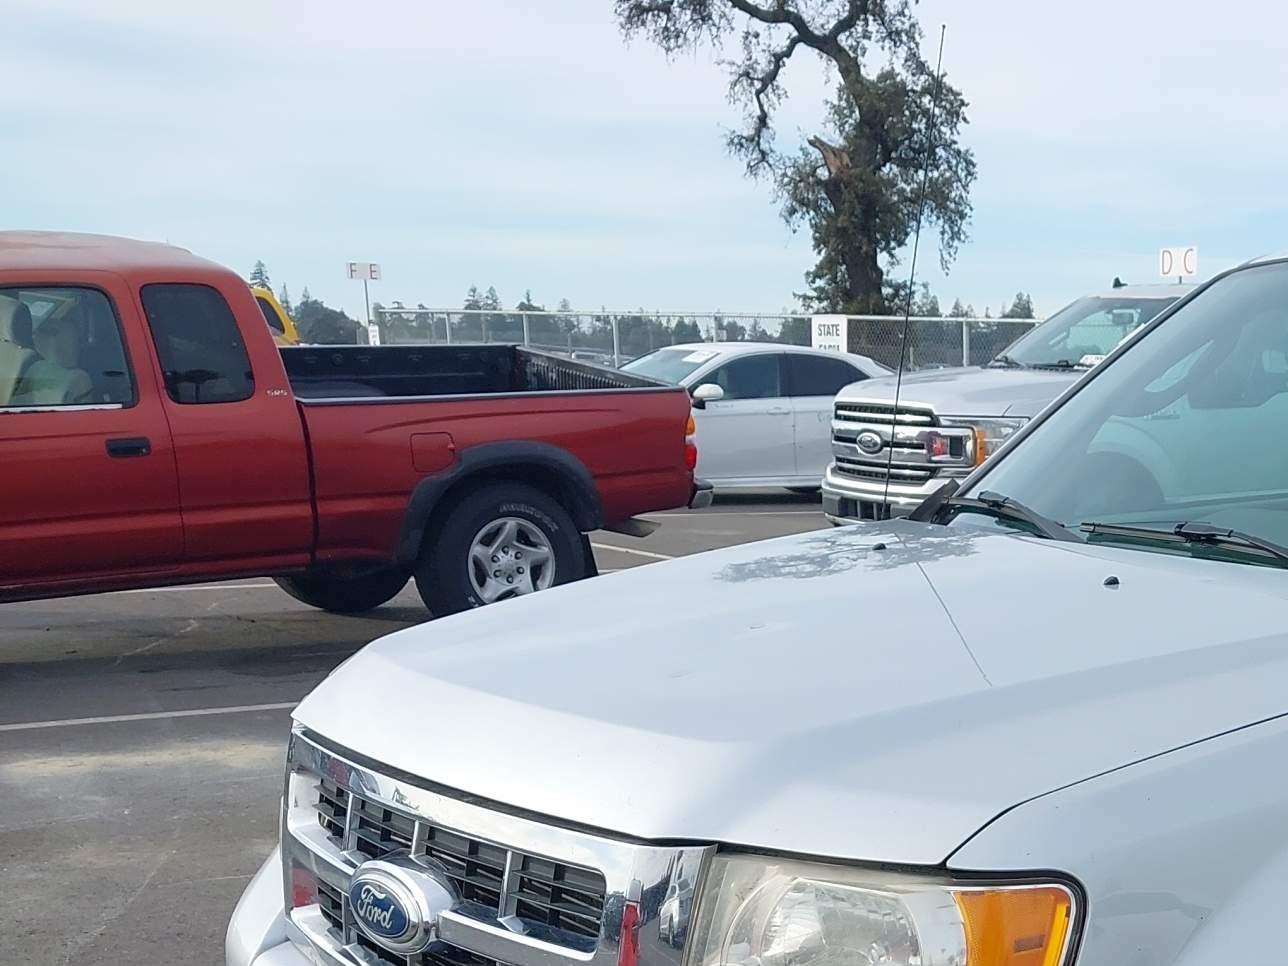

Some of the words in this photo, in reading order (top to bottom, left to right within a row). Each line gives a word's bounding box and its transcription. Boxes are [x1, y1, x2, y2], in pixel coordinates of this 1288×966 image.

[349, 262, 358, 279] F
[369, 263, 378, 280] E
[1162, 249, 1173, 275] D
[1183, 248, 1194, 274] C
[817, 323, 841, 337] STATE
[357, 884, 395, 929] Ford
